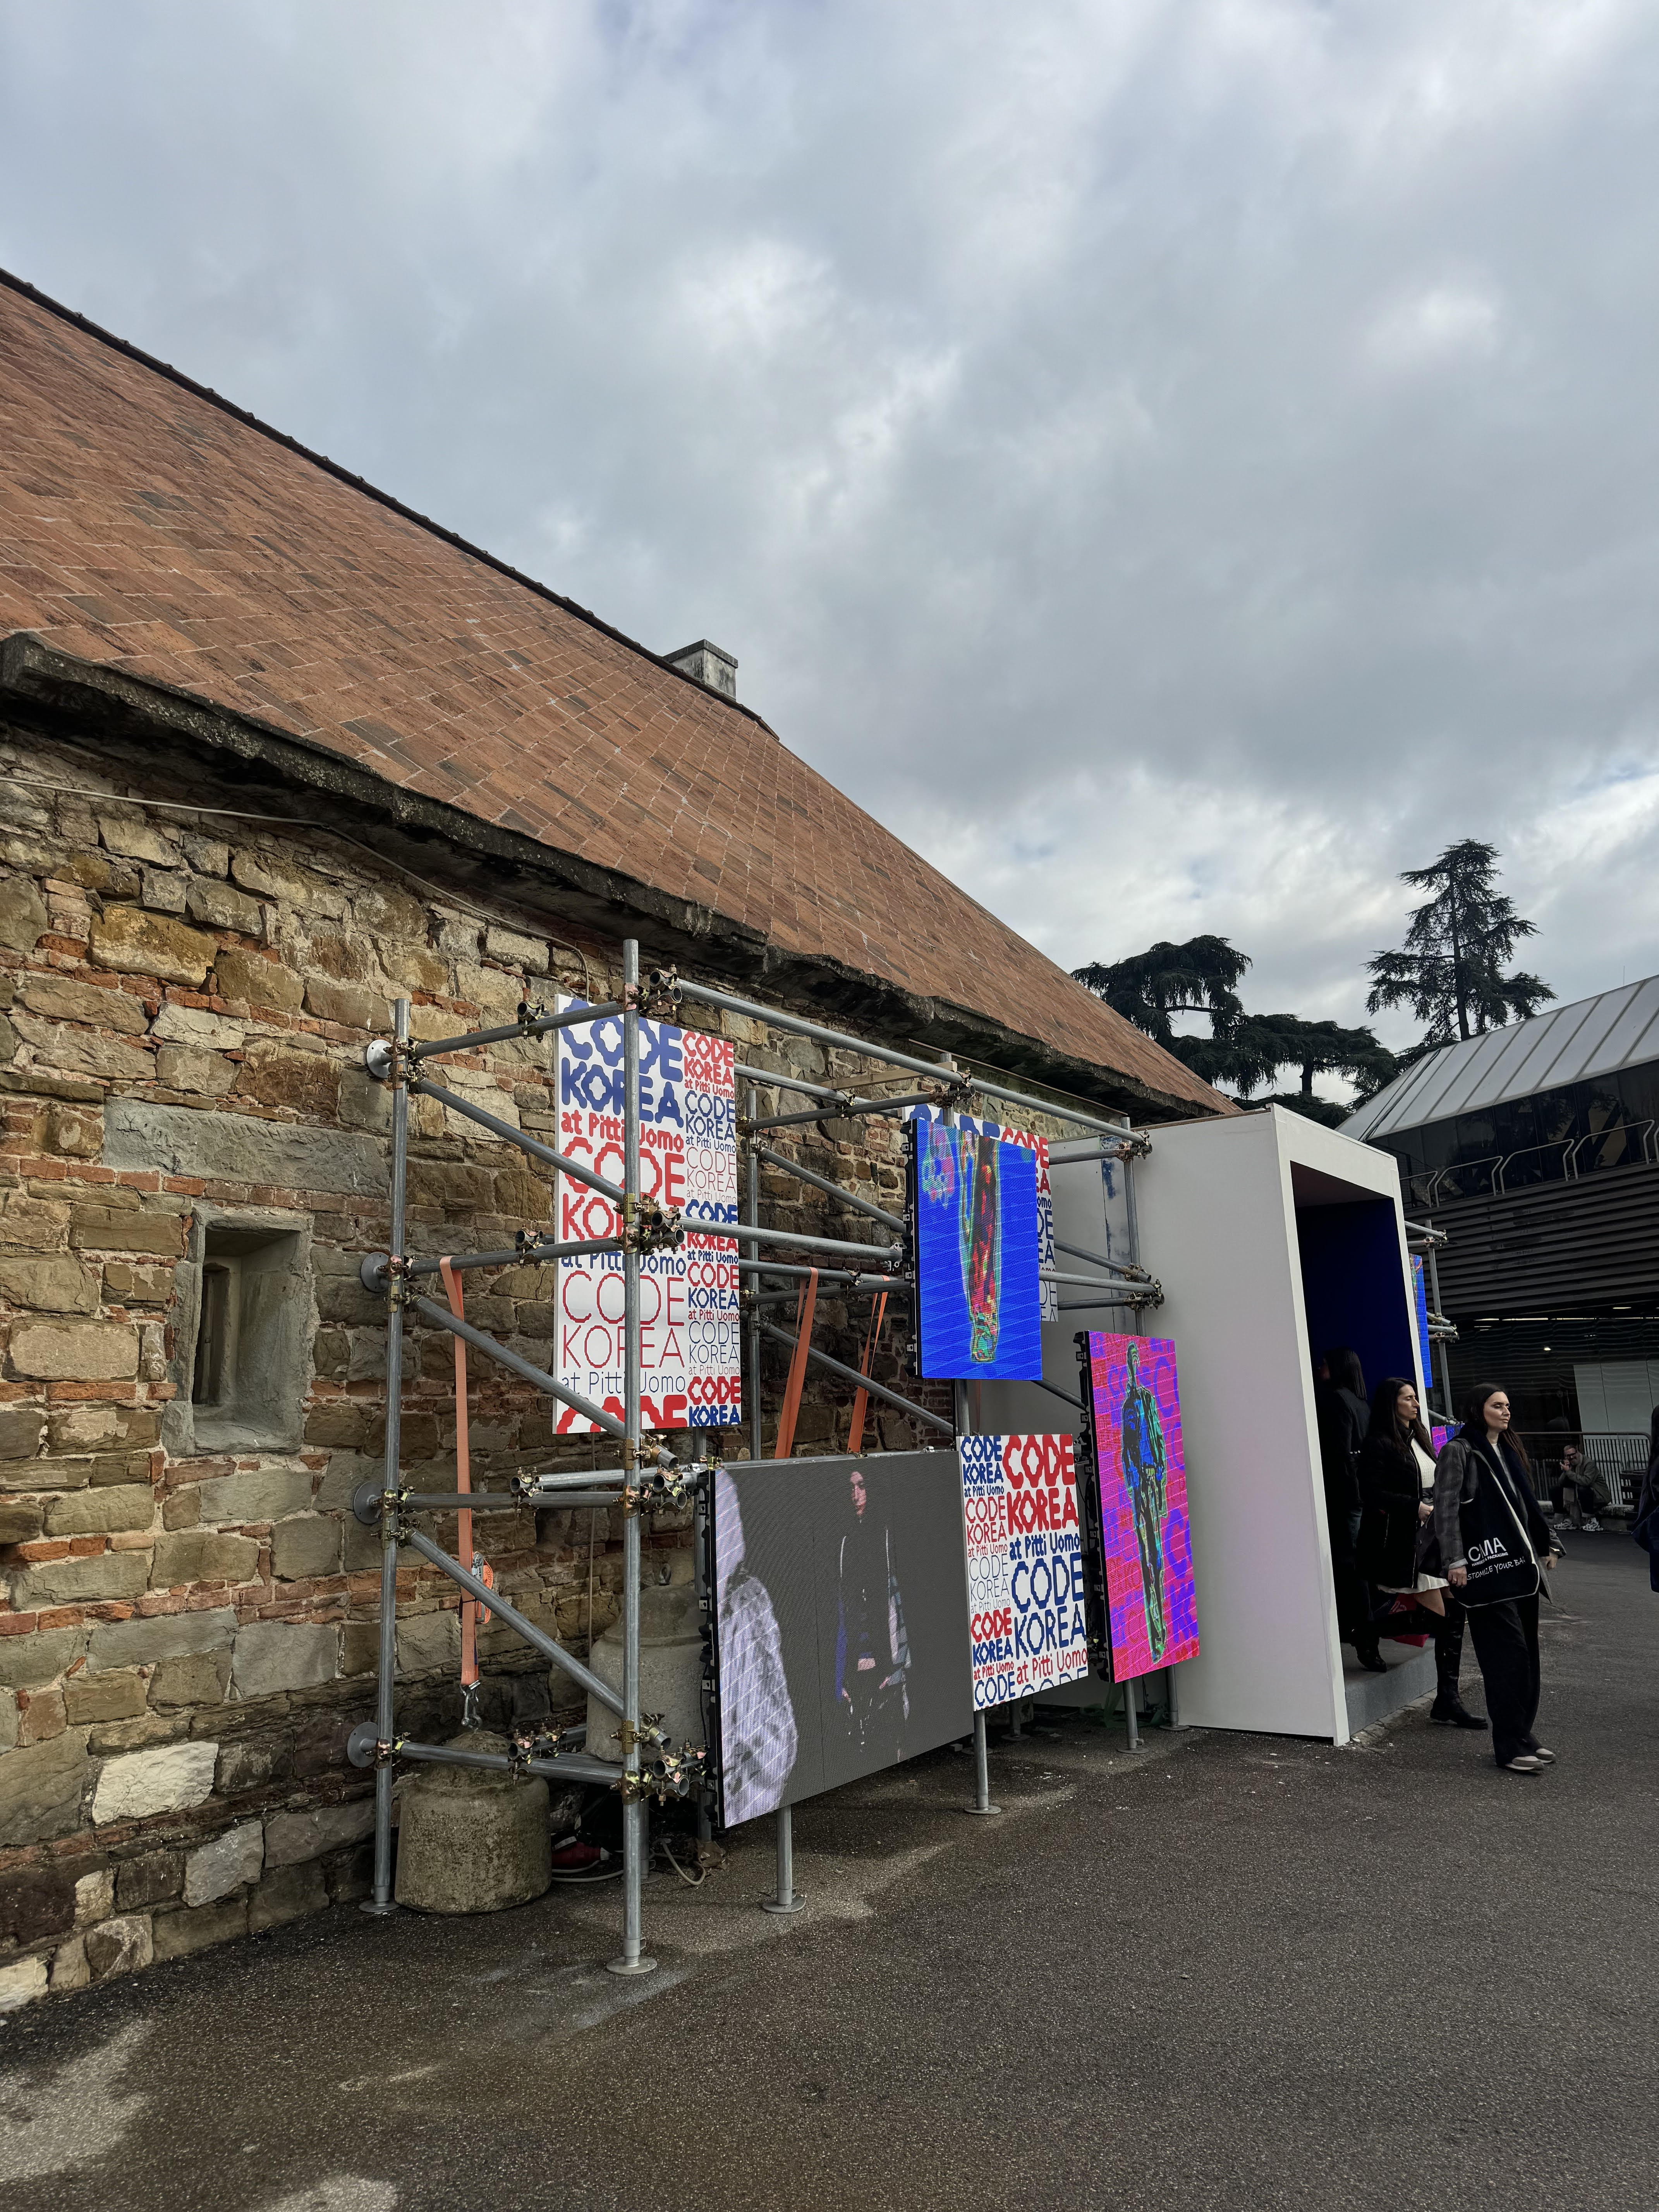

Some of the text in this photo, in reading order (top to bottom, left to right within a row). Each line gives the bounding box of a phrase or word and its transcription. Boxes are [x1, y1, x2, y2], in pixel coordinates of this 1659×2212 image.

[683, 1030, 734, 1068] CODE
[684, 1056, 735, 1087] KOREA
[684, 1079, 735, 1099] at Pitti Uomo
[685, 1090, 735, 1123] CODE
[561, 1110, 582, 1135] at
[686, 1113, 736, 1143] KOREA
[686, 1135, 736, 1154] at Pitti Uomo
[687, 1147, 736, 1176] CODE
[687, 1170, 736, 1194] KOREA
[687, 1188, 737, 1204] at Pitti Uomo
[685, 1199, 738, 1224] CODE
[687, 1250, 738, 1265] at Pitti Uomo
[687, 1262, 739, 1289] CODE
[563, 1271, 684, 1326] CODE
[688, 1287, 740, 1310] KOREA
[688, 1309, 740, 1322] at Pitti Uomo
[689, 1321, 740, 1345] CODE
[689, 1344, 740, 1364] KOREA
[589, 1371, 622, 1394] Pitt
[688, 1364, 740, 1376] at Pitti Uomo
[687, 1376, 740, 1405] CODE
[689, 1405, 741, 1427] KOREA
[960, 1436, 1002, 1462] CODE
[963, 1463, 1004, 1485] KOREA
[1002, 1434, 1075, 1490] CODE
[964, 1484, 1004, 1497] at Pitti Uomo
[965, 1496, 1006, 1523] CODE
[1007, 1487, 1079, 1536] KOREA
[967, 1522, 1007, 1546] KOREA
[1009, 1537, 1022, 1561] at
[1025, 1534, 1047, 1559] Pitti
[1049, 1532, 1080, 1554] Uomo
[968, 1542, 1008, 1558] at Pitti Uomo
[1468, 1537, 1506, 1561] CMA
[969, 1554, 1008, 1582] CODE
[1467, 1565, 1493, 1580] STOMIZE
[1494, 1561, 1514, 1574] YOUR
[970, 1577, 1009, 1603] KOREA
[1011, 1552, 1084, 1614] CODE
[971, 1597, 1011, 1614] at Pitti Uomo
[971, 1607, 1012, 1643] CODE
[1014, 1603, 1086, 1660] KOREA
[972, 1637, 1014, 1667] KOREA
[974, 1661, 1014, 1681] at Pitti Uomo
[1017, 1661, 1029, 1685] at
[1032, 1654, 1053, 1680] Pitti
[1056, 1647, 1088, 1672] Uomo
[974, 1671, 1015, 1707] CODE
